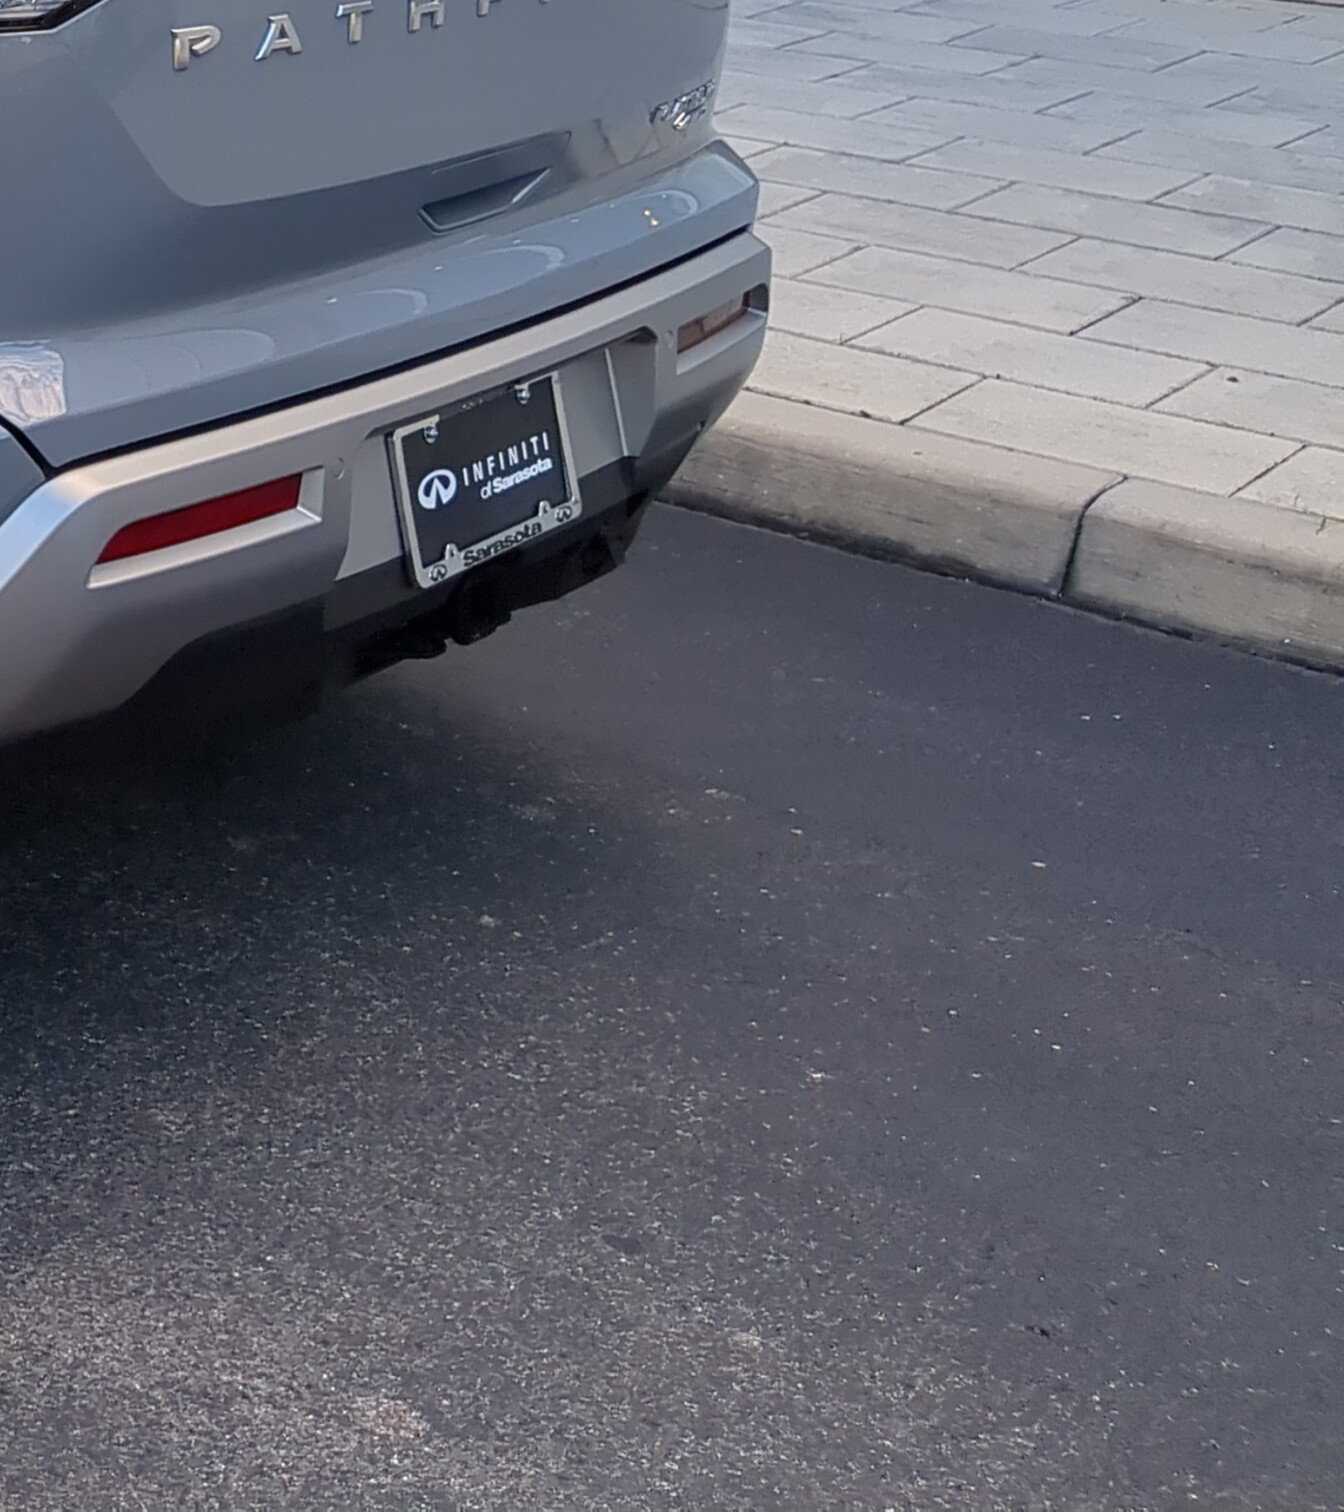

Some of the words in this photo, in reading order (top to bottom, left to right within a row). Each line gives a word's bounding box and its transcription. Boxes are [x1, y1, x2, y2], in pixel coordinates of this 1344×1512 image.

[462, 431, 550, 487] INFINITI
[493, 457, 554, 494] Sarasota
[462, 521, 543, 567] Sarasota
